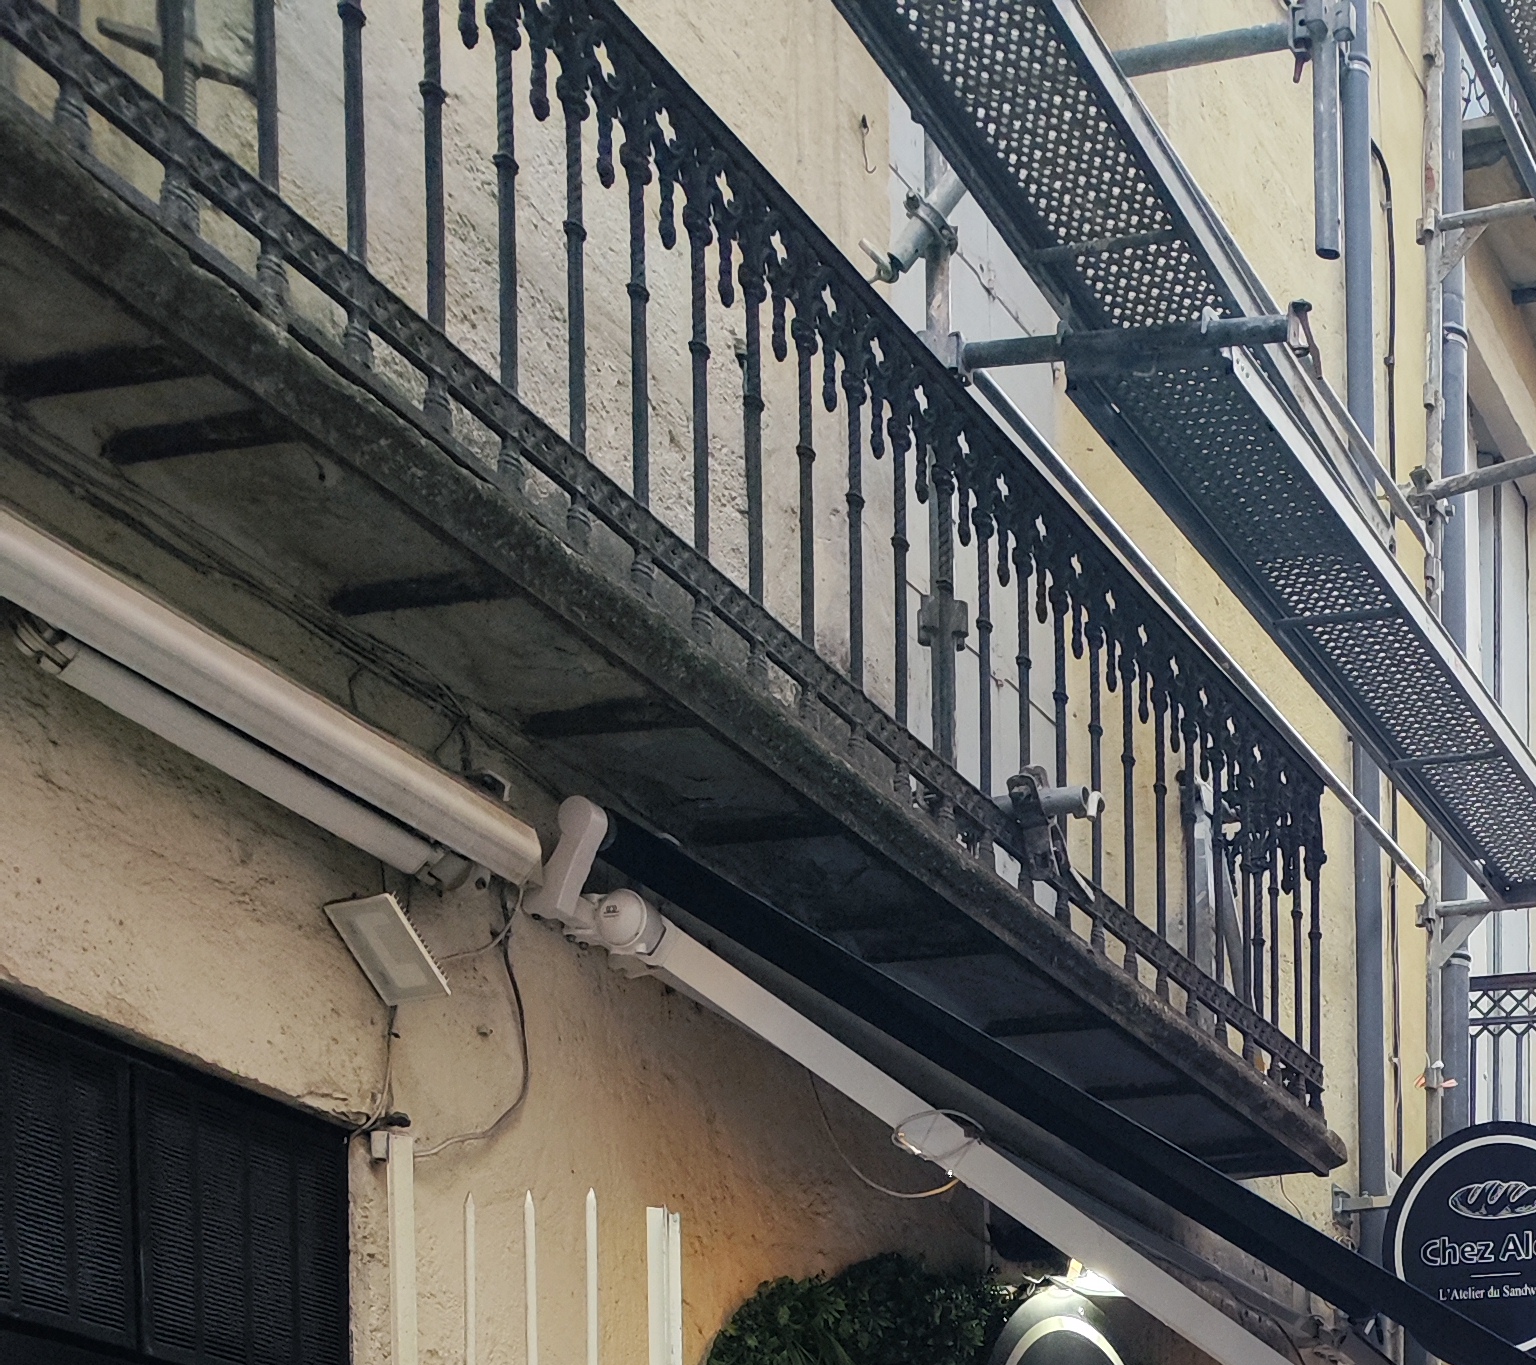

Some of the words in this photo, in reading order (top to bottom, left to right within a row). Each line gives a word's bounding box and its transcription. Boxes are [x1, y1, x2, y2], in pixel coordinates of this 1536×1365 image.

[1420, 1236, 1494, 1266] Chez
[1439, 1286, 1486, 1301] L'Atelier
[1487, 1285, 1500, 1298] du
